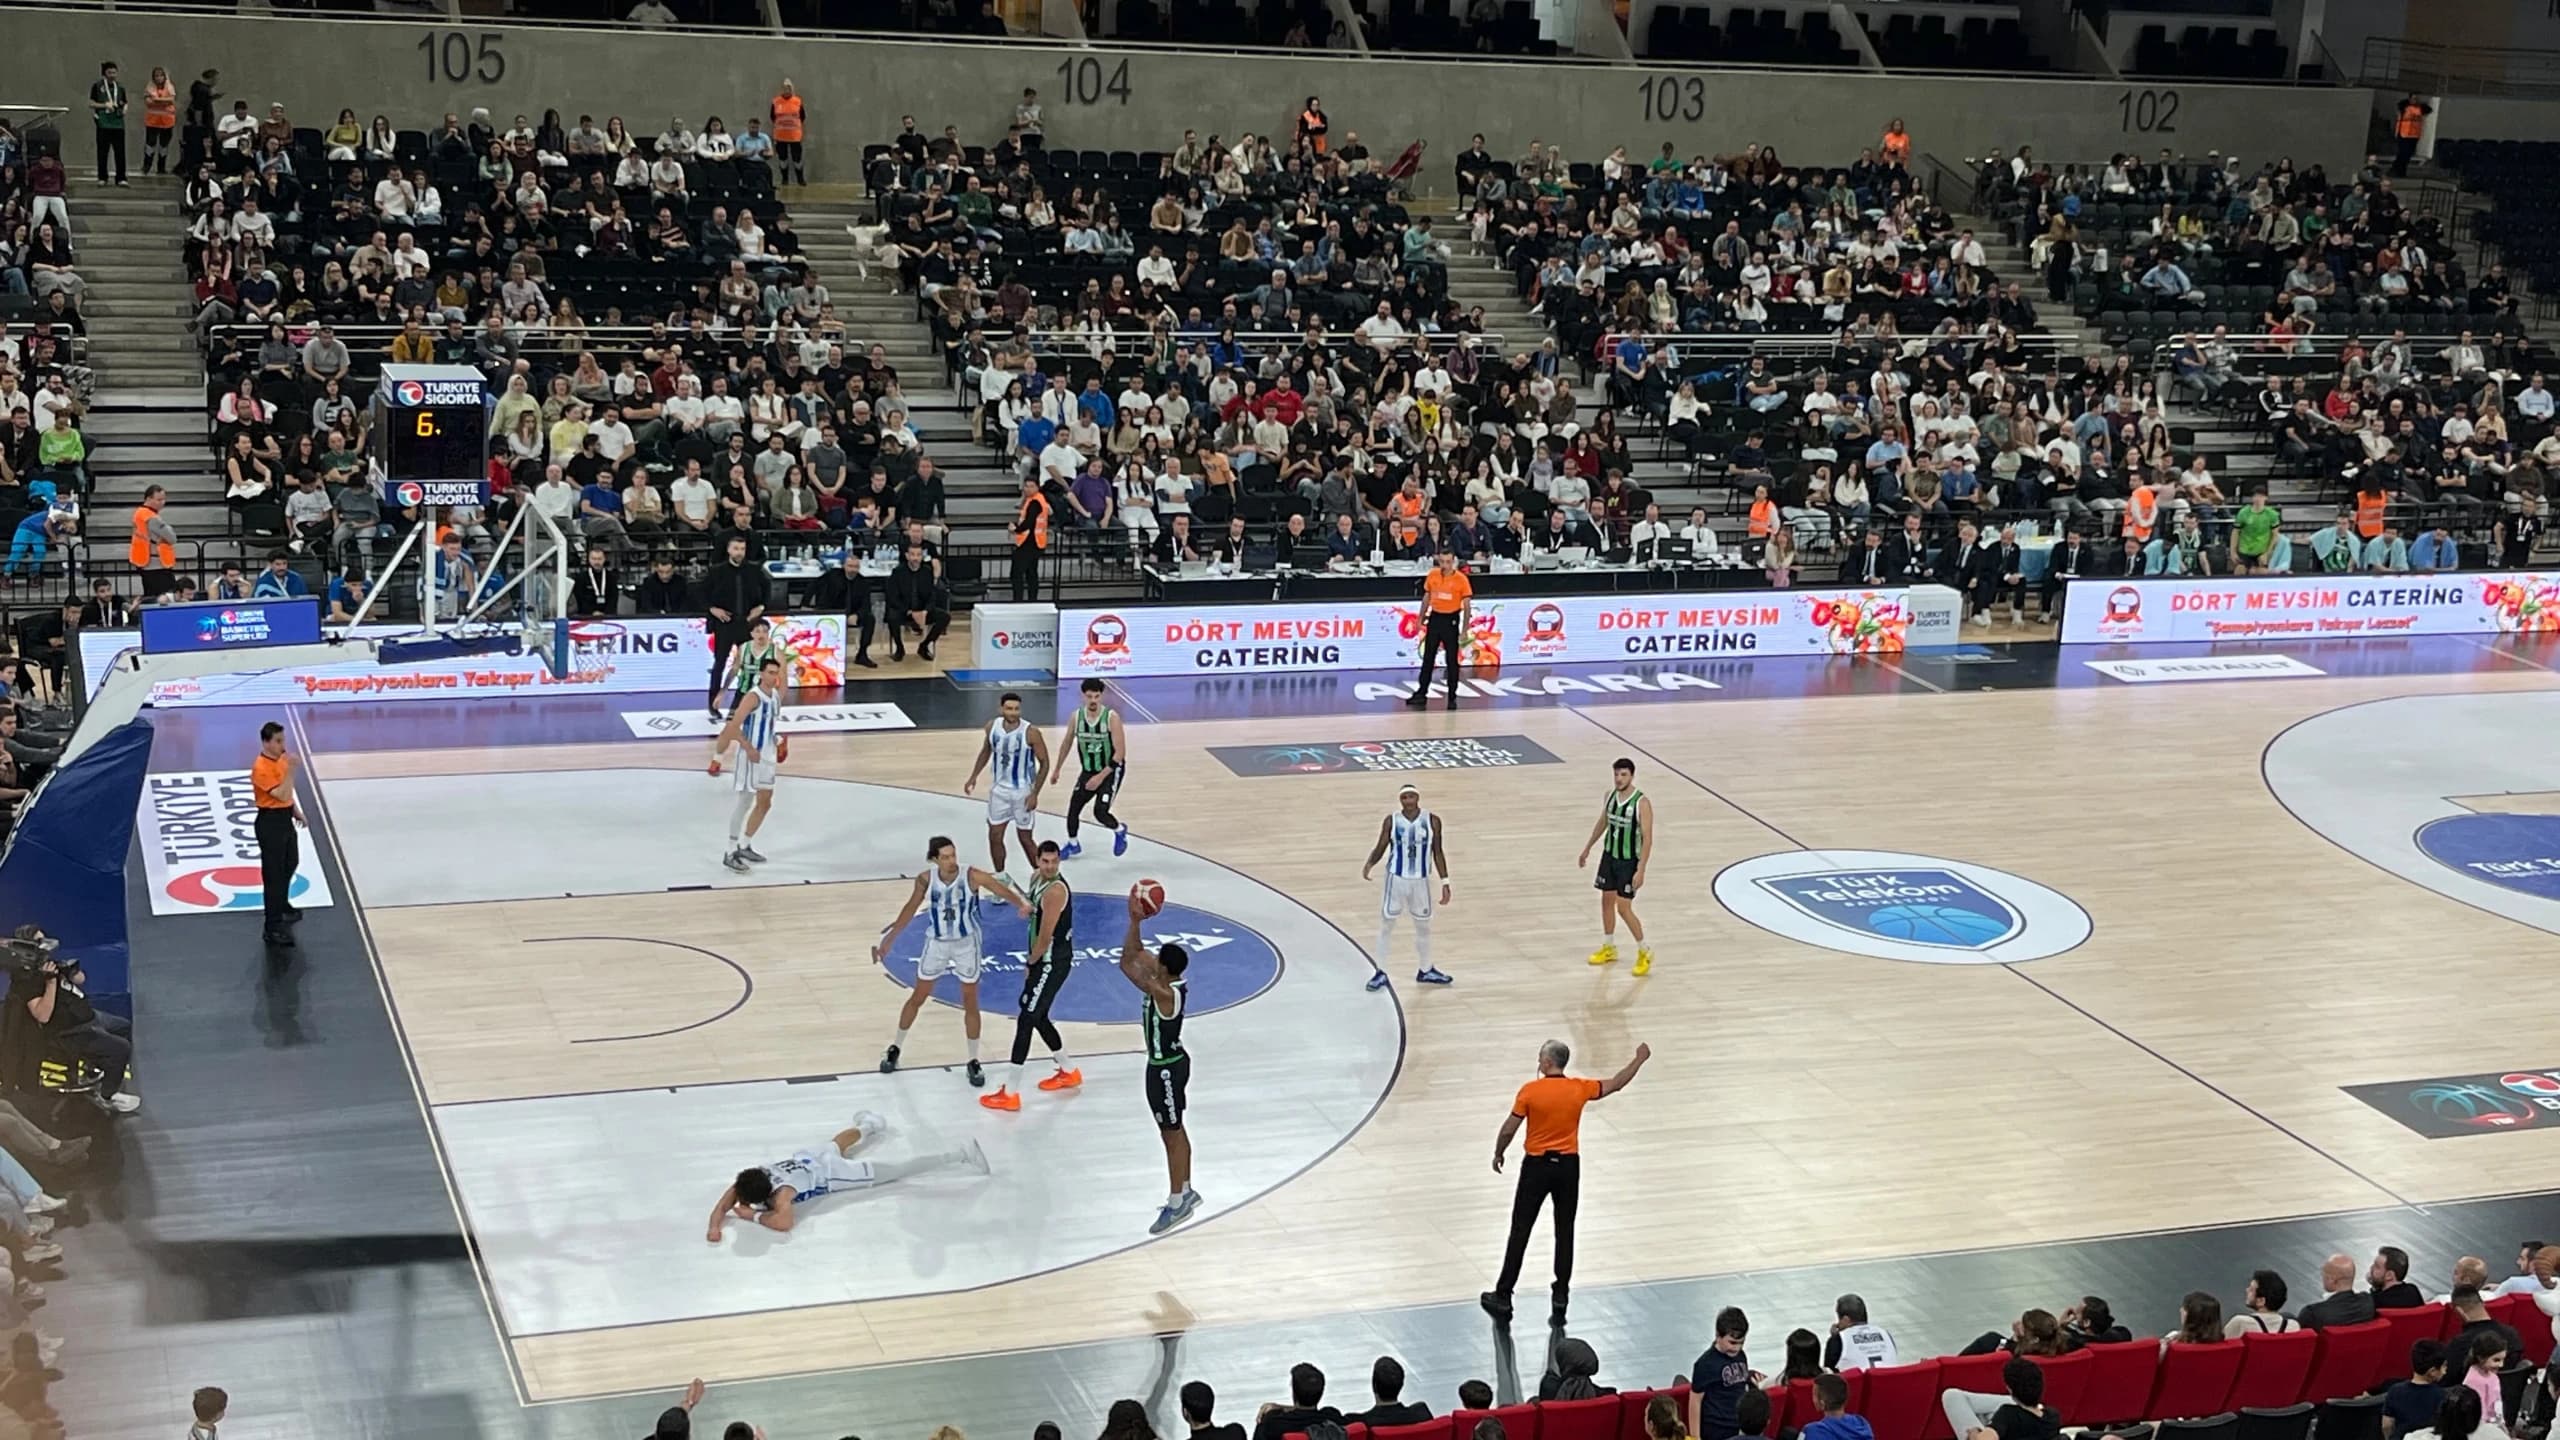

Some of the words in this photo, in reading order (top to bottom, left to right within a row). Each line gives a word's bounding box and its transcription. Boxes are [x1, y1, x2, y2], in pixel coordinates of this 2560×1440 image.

[417, 31, 505, 84] 105
[1057, 56, 1132, 106] 104
[1638, 76, 1704, 121] 103
[2118, 90, 2179, 132] 102
[2170, 590, 2238, 612] DÖRT
[2245, 586, 2339, 610] MEVSİM
[2346, 583, 2464, 608] CATERİNG
[1165, 619, 1243, 643] DÖRT
[1252, 614, 1364, 640] MEVSİM
[1597, 606, 1676, 630] DÖRT
[1678, 603, 1780, 627] MEVSİM
[1196, 641, 1341, 668] CATERİNG
[1625, 629, 1758, 654] CATERİNG
[1353, 672, 1723, 701] ANKARA
[1797, 883, 1964, 903] Telekom
[1815, 873, 1907, 889] Türk
